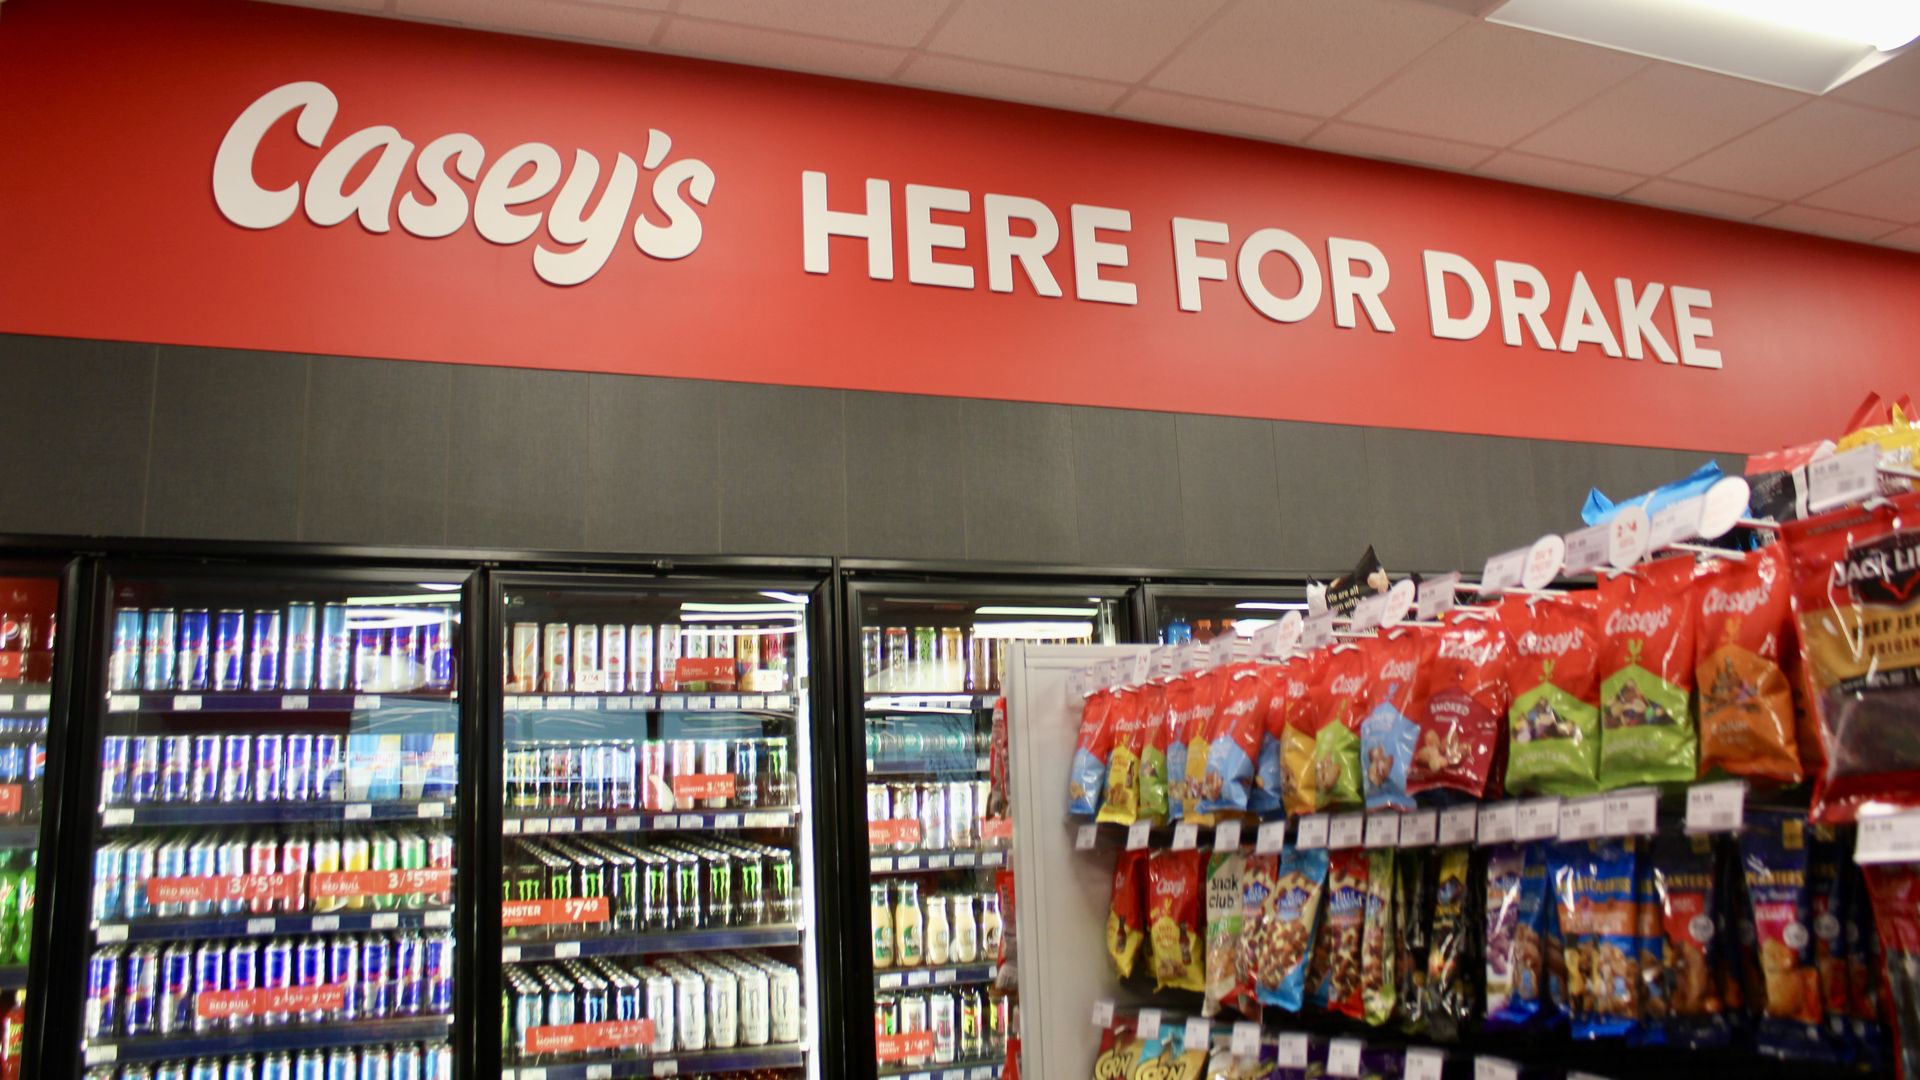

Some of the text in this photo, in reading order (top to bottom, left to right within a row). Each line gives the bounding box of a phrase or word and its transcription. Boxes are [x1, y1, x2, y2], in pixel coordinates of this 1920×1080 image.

[212, 80, 716, 288] Casey's
[802, 170, 1723, 369] HERE FOR DRAKE
[1833, 551, 1894, 588] JACK
[1338, 590, 1349, 601] are
[1349, 585, 1359, 597] all
[1702, 585, 1772, 617] Casey's
[1605, 604, 1673, 637] Casey's
[1517, 626, 1585, 656] Casey's
[1430, 700, 1470, 716] SMOKED
[1211, 873, 1238, 891] snak
[503, 905, 541, 918] ONSTER
[1208, 893, 1235, 909] club
